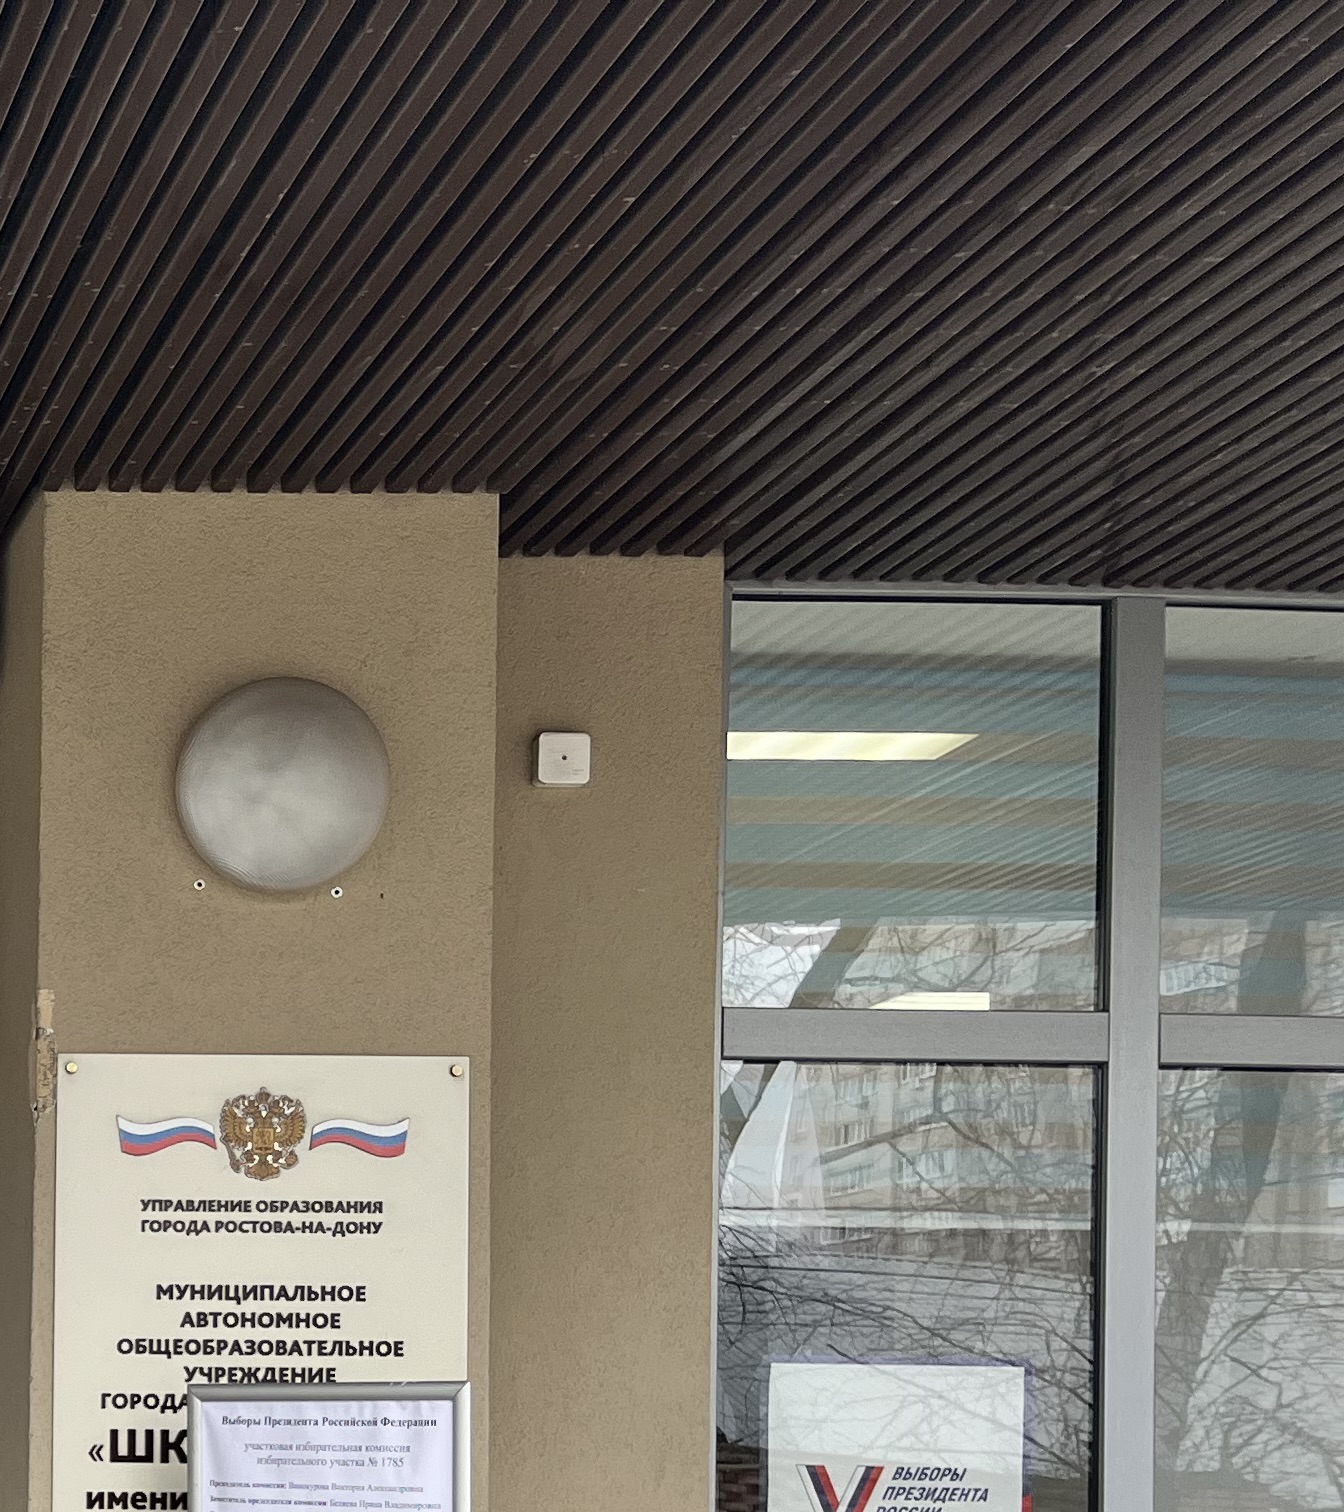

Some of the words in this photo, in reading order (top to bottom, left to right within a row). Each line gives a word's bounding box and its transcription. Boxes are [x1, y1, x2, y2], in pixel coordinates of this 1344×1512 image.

[140, 1199, 252, 1213] УПРАВЛЕНИЕ
[255, 1200, 384, 1215] ОБРАЗОВАНИЯ
[140, 1219, 211, 1236] ГОРОДА
[214, 1220, 384, 1237] РОСТОВА-НА-ДОНУ
[155, 1284, 367, 1305] МУНИЦИПАЛЬНОЕ
[180, 1312, 341, 1329] АВТОНОМНОЕ
[116, 1338, 404, 1359] ОБЩЕОБРАЗОВАТЕЛЬНОЕ
[183, 1366, 337, 1383] УЧРЕЖДЕНИЕ
[221, 1416, 261, 1427] Выборы
[264, 1416, 319, 1428] Президента
[322, 1417, 378, 1426] Российской
[380, 1417, 437, 1428] Федерации
[244, 1443, 293, 1453] участковая
[295, 1441, 363, 1453] избирательная
[365, 1444, 411, 1452] комиссия
[329, 1458, 365, 1468] участка
[381, 1458, 404, 1467] 1785
[891, 1466, 967, 1482] ВЫБОРЫ
[86, 1491, 188, 1510] имени
[882, 1486, 989, 1504] ПРЕЗИДЕНТА
